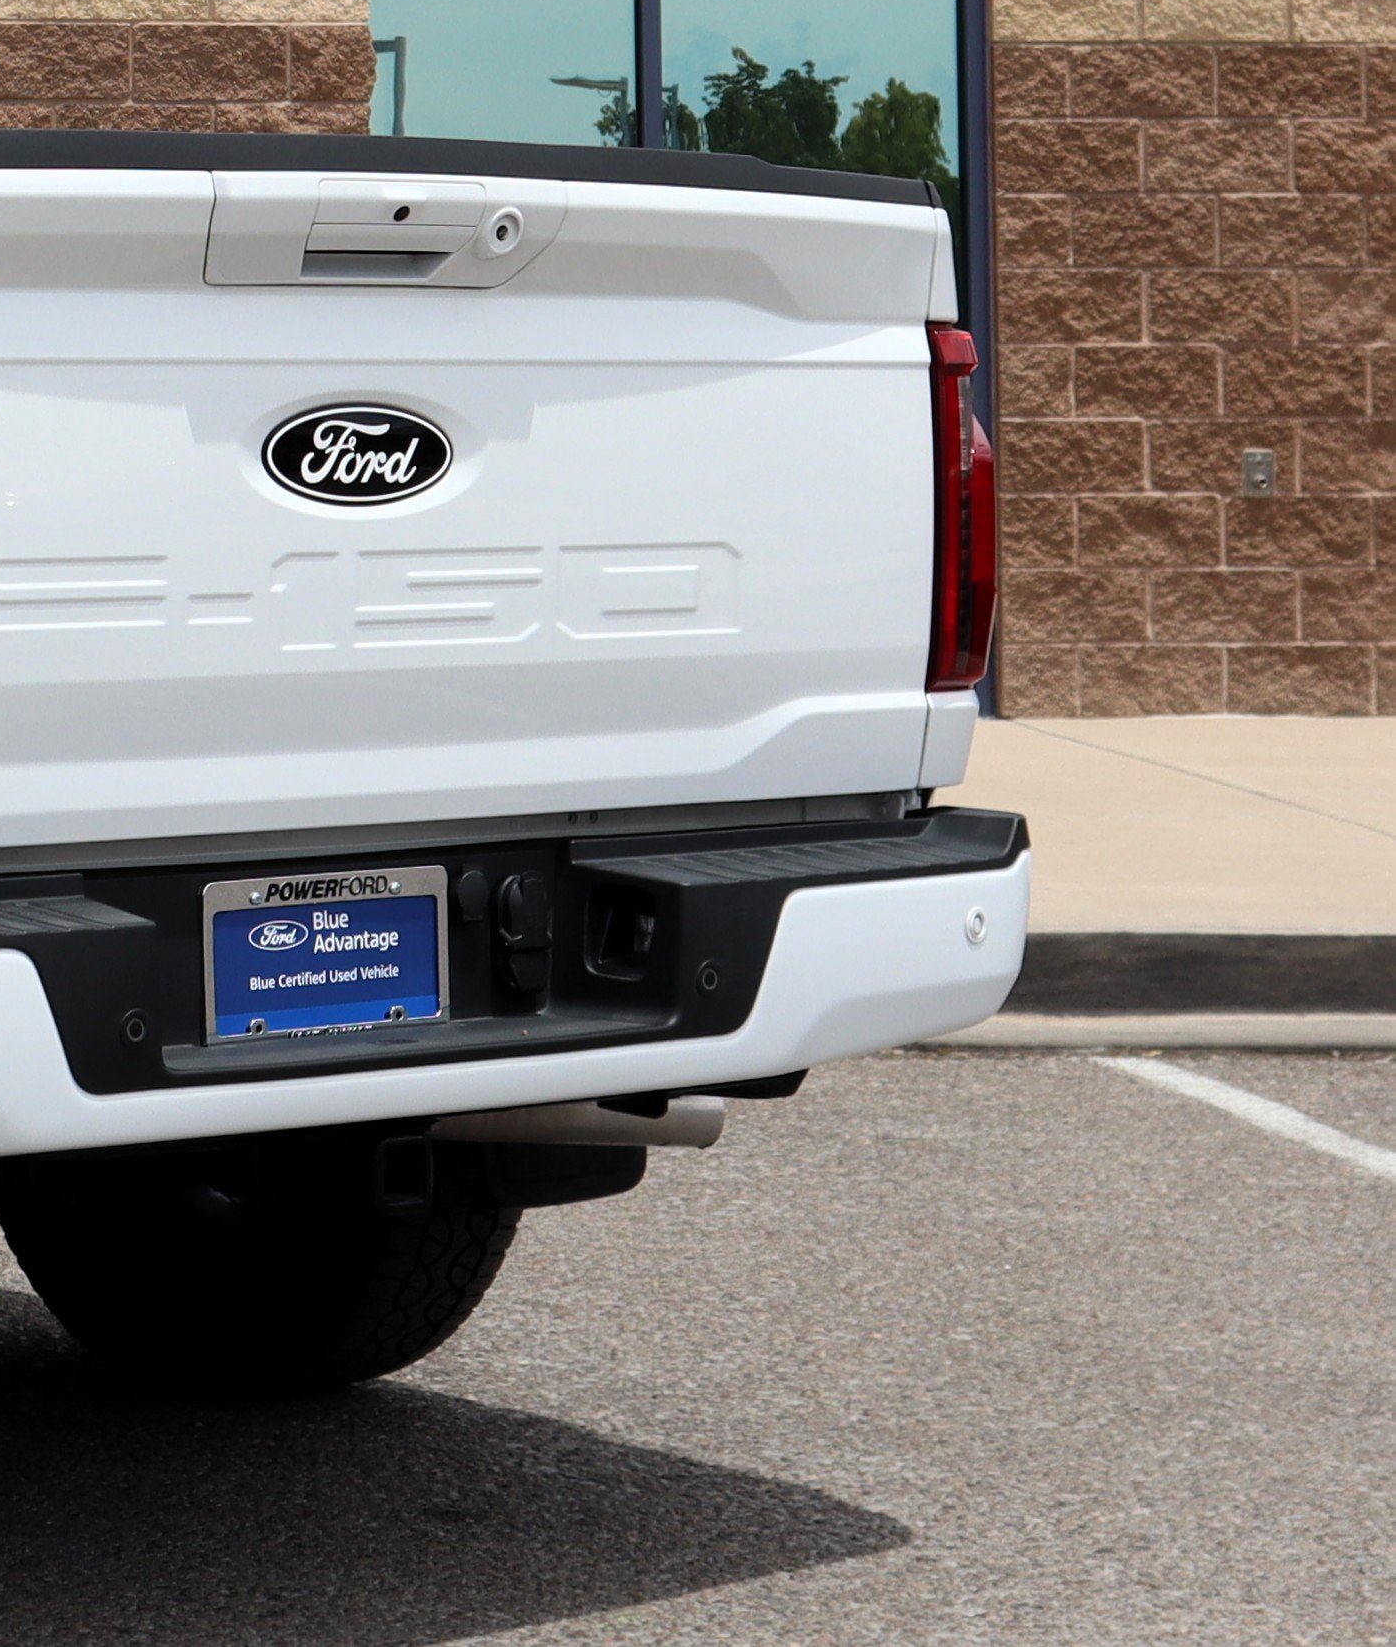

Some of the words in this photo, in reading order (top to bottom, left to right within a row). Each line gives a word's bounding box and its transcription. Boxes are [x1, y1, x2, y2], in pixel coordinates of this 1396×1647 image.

[300, 419, 420, 485] Ford
[264, 874, 389, 903] POWERFORD
[312, 909, 349, 930] Blue
[259, 924, 297, 946] Ford
[313, 929, 399, 954] Advantage
[249, 975, 276, 991] Blue
[278, 971, 327, 989] Certified
[329, 966, 358, 983] Used
[360, 963, 399, 981] Vehicle
